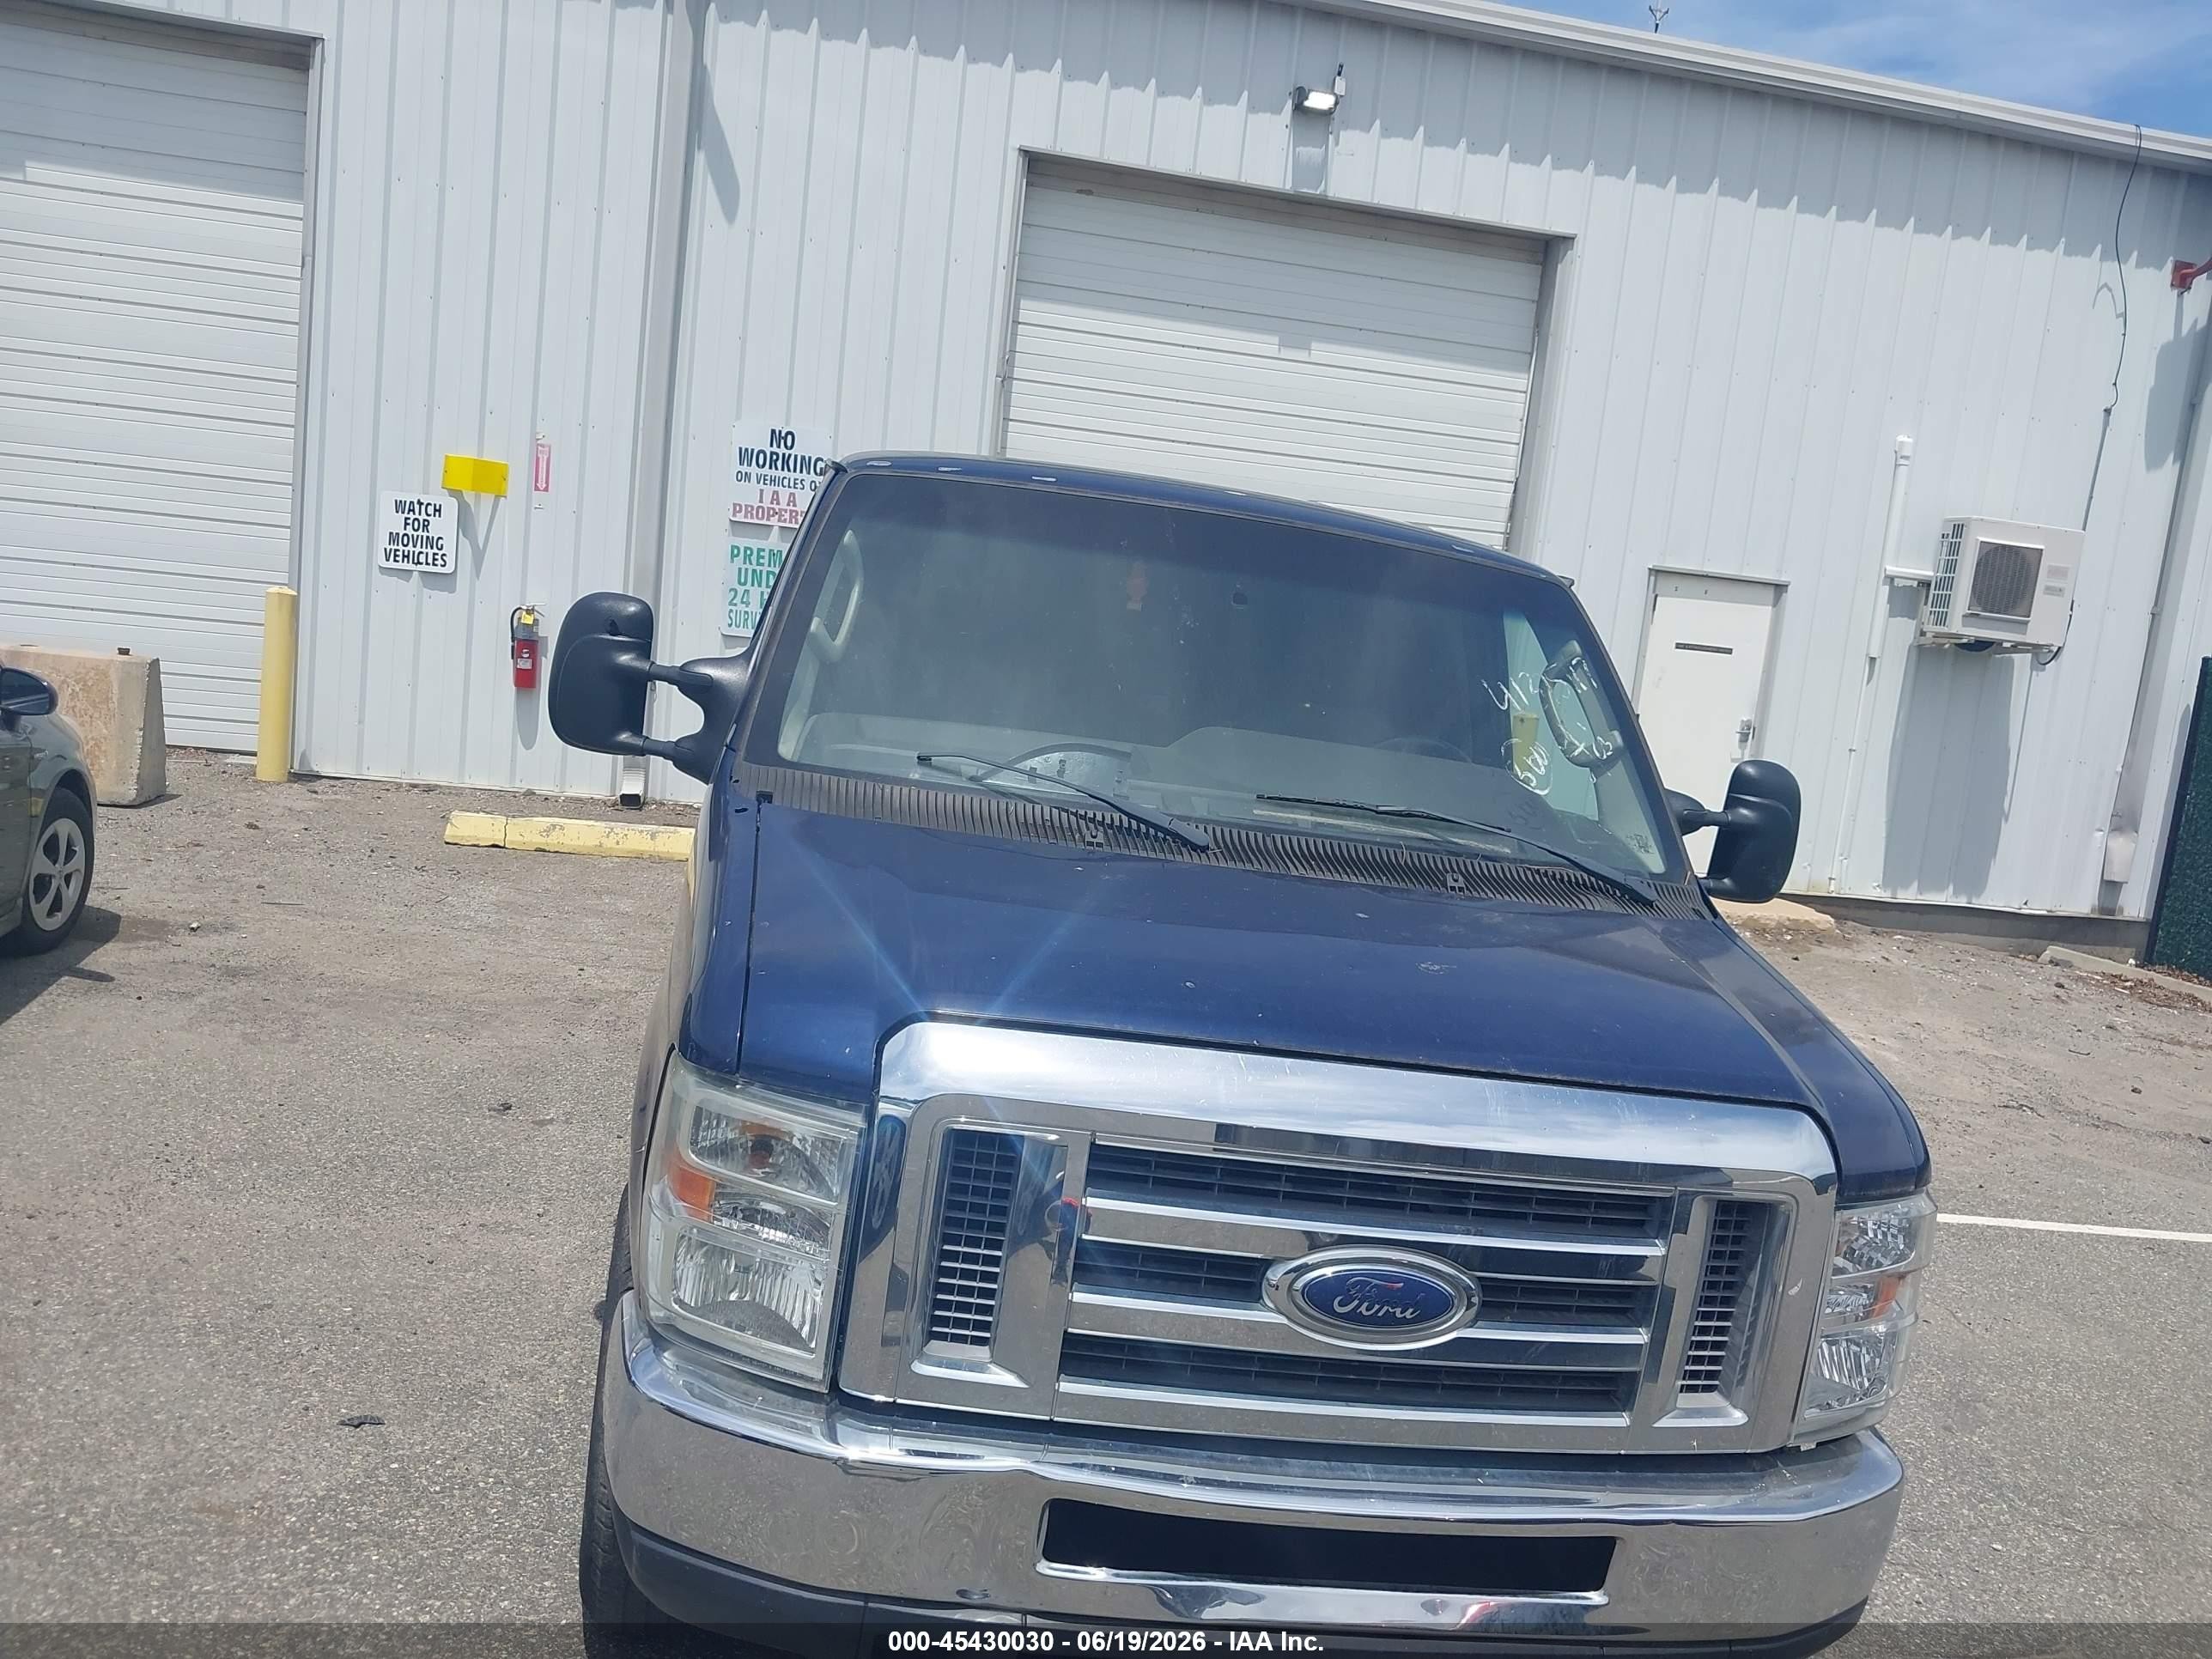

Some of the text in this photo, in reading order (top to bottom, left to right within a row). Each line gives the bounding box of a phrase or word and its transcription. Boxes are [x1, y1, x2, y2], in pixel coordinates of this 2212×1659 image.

[769, 428, 796, 451] NO
[738, 446, 824, 477] WORKING
[736, 470, 822, 493] ON VEHICLES O
[394, 498, 442, 519] WATCH
[404, 516, 431, 534] FOR
[388, 531, 445, 552] MOVING
[384, 547, 448, 568] VEHICLES
[727, 587, 750, 608] 24
[727, 608, 761, 630] SURV
